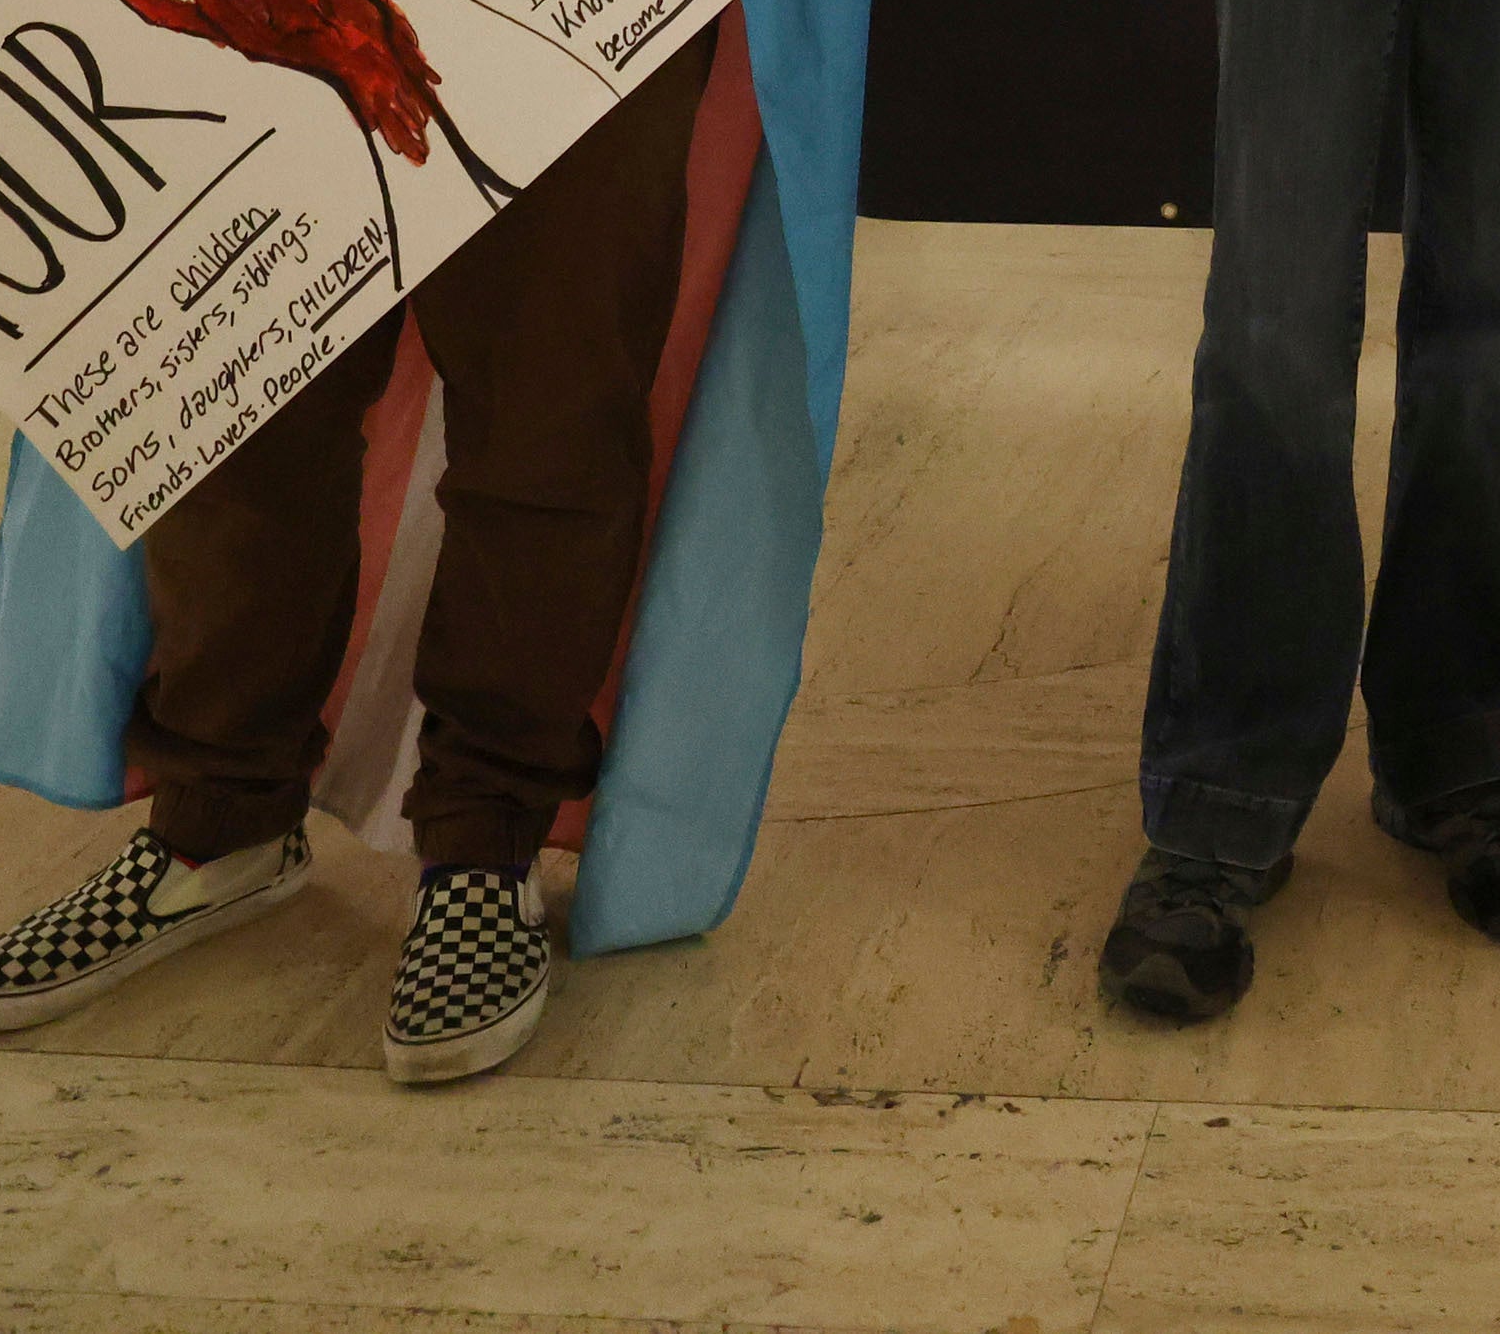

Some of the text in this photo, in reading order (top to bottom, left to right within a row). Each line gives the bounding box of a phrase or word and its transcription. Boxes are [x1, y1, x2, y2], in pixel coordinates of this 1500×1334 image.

[24, 345, 118, 428] These
[117, 306, 163, 358] are
[55, 213, 319, 472] Brothers, sisters, siblings.
[179, 319, 293, 430] daughters,
